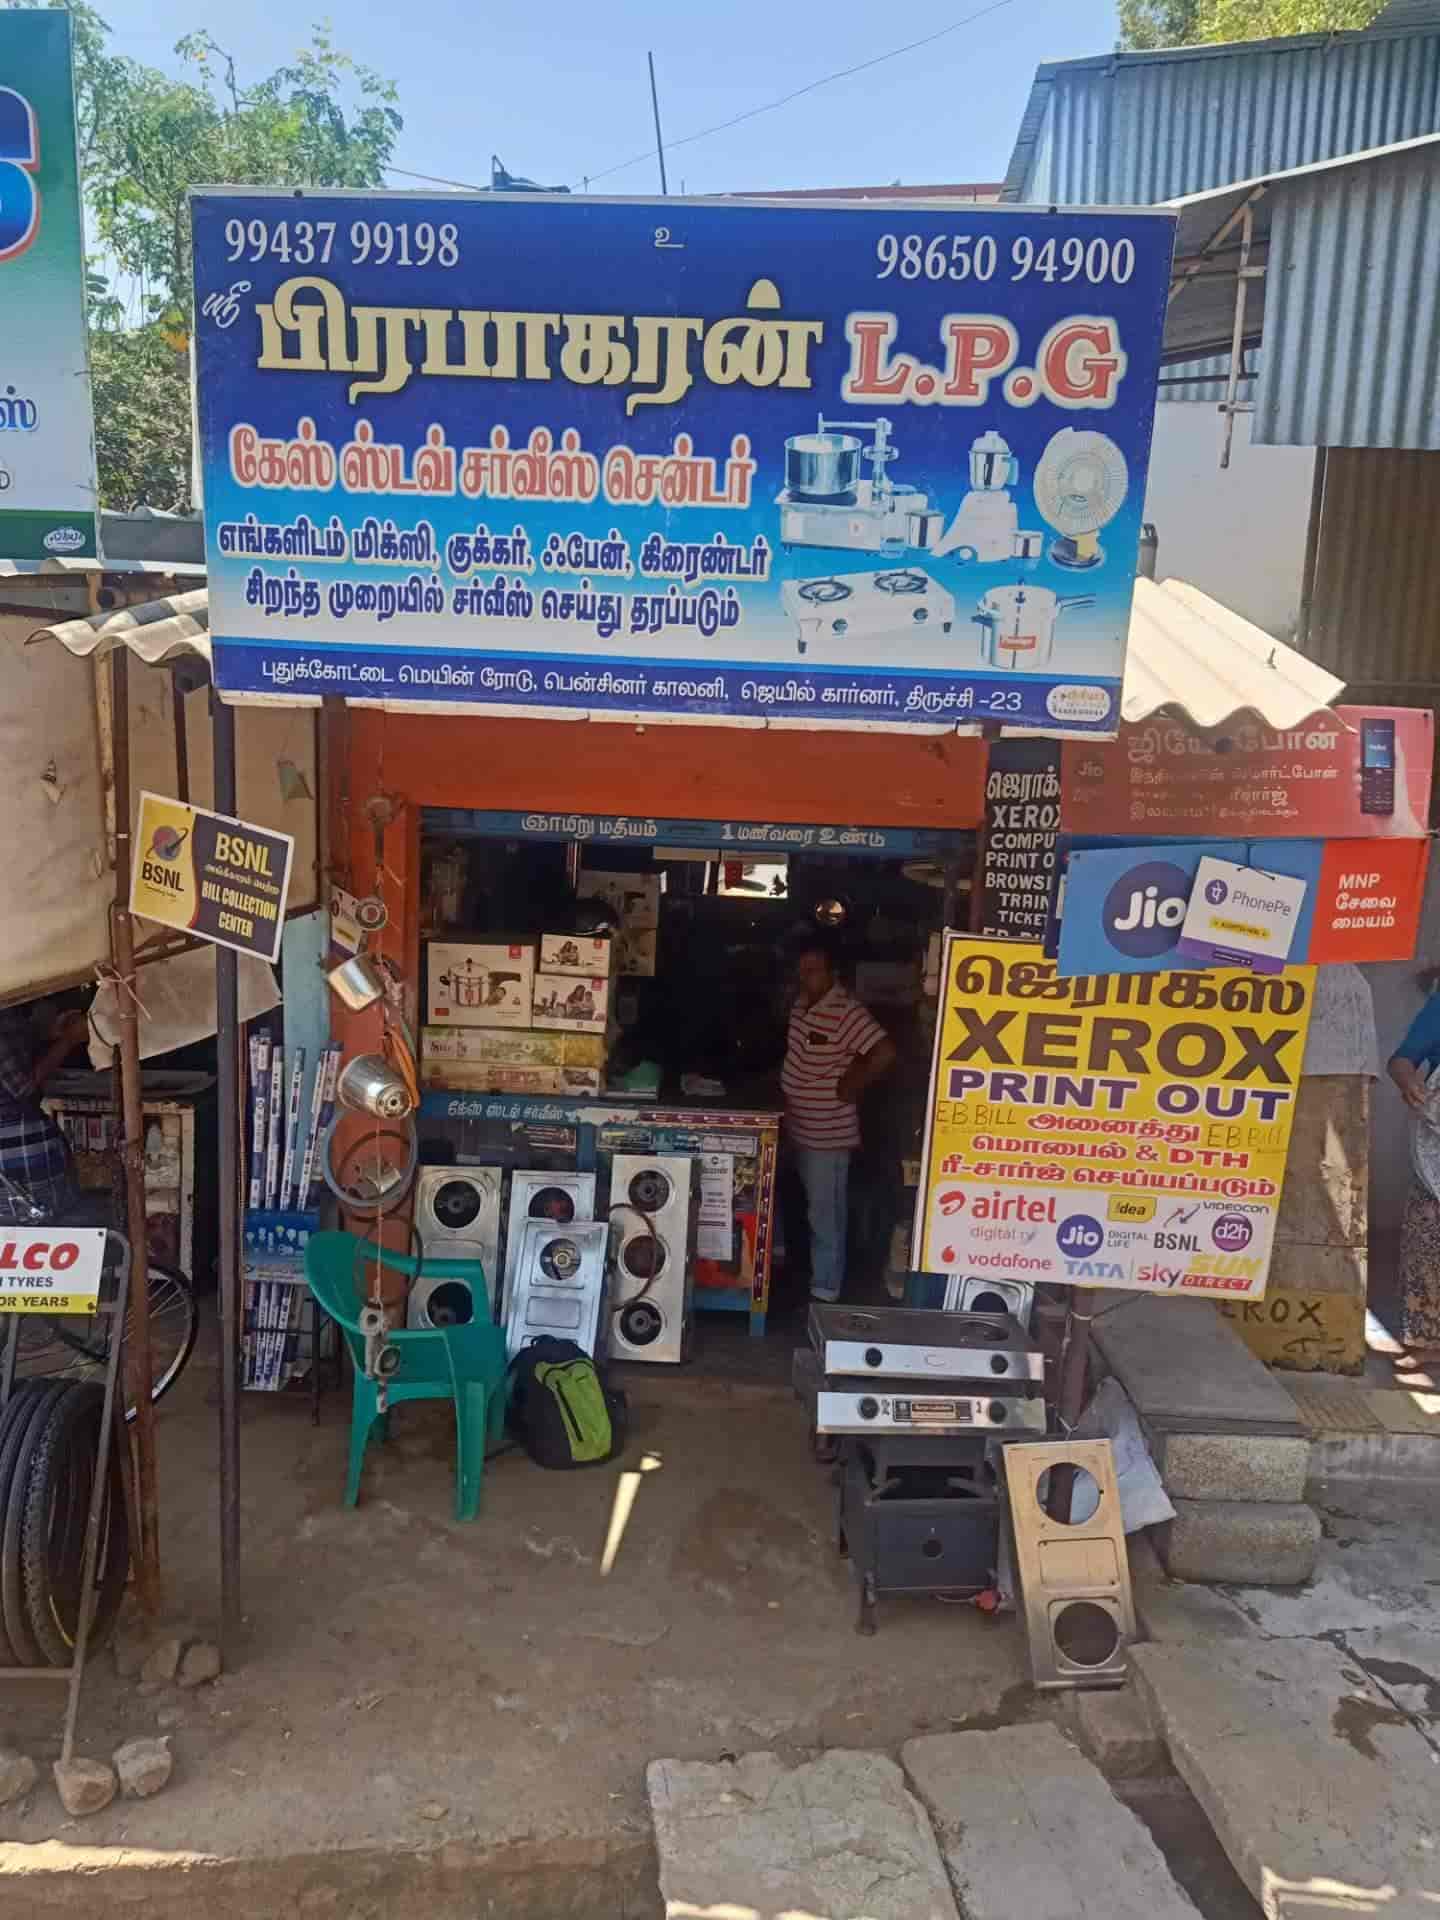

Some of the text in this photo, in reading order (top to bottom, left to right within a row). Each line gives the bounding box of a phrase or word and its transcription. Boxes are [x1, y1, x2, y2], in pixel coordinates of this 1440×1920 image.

[224, 218, 460, 268] 99437 99198
[876, 234, 1136, 285] 98650 94900
[255, 276, 824, 417] பிரபாகரன்
[841, 311, 1128, 409] L.P.G
[229, 417, 757, 509] கேஸ் ஸ்டவ் சர்வீஸ் சென்டர்
[218, 512, 349, 560] எங்களிடம்
[639, 532, 771, 586] கிரைண்டர்
[245, 567, 740, 638] சிறந்த முறையில் சர்வீஸ் செய்து தரப்படும்
[262, 656, 394, 686] புதுக்கோட்டை
[399, 664, 475, 690] மெயின்
[741, 680, 816, 704] ஜெயில்
[904, 687, 973, 713] திருச்சி
[598, 818, 659, 839] மதியம்
[215, 832, 274, 877] BSNL
[985, 851, 1040, 868] PRINT
[142, 862, 185, 892] BSNL
[1339, 873, 1381, 889] MNP
[201, 880, 221, 904] BILL
[222, 884, 279, 921] COLLECTION
[1114, 886, 1186, 931] Jio
[1231, 890, 1292, 917] PhonePe
[1335, 892, 1397, 911] சேவை
[218, 911, 254, 939] CENTER
[1331, 911, 1396, 930] மையம்
[945, 1006, 1300, 1084] XEROX
[946, 1068, 1292, 1121] PRINT OUT
[974, 1104, 1017, 1126] BILL
[1027, 1112, 1200, 1142] அனைத்து
[1207, 1123, 1241, 1149] EB
[972, 1133, 1250, 1169] மொபைல் & DTH
[1072, 1165, 1277, 1198] செய்யப்படும்
[971, 1190, 1057, 1224] airtel
[1061, 1225, 1100, 1247] Jio
[1106, 1239, 1130, 1249] LIFE
[1107, 1230, 1149, 1241] DIGITAL
[1153, 1231, 1203, 1252] BSNL
[1215, 1222, 1249, 1241] d2h
[967, 1251, 1053, 1271] vodafone
[1064, 1260, 1183, 1289] TATA sky
[1187, 1253, 1263, 1277] SUN
[8, 1276, 54, 1288] TYRES
[22, 1296, 70, 1308] YEARS
